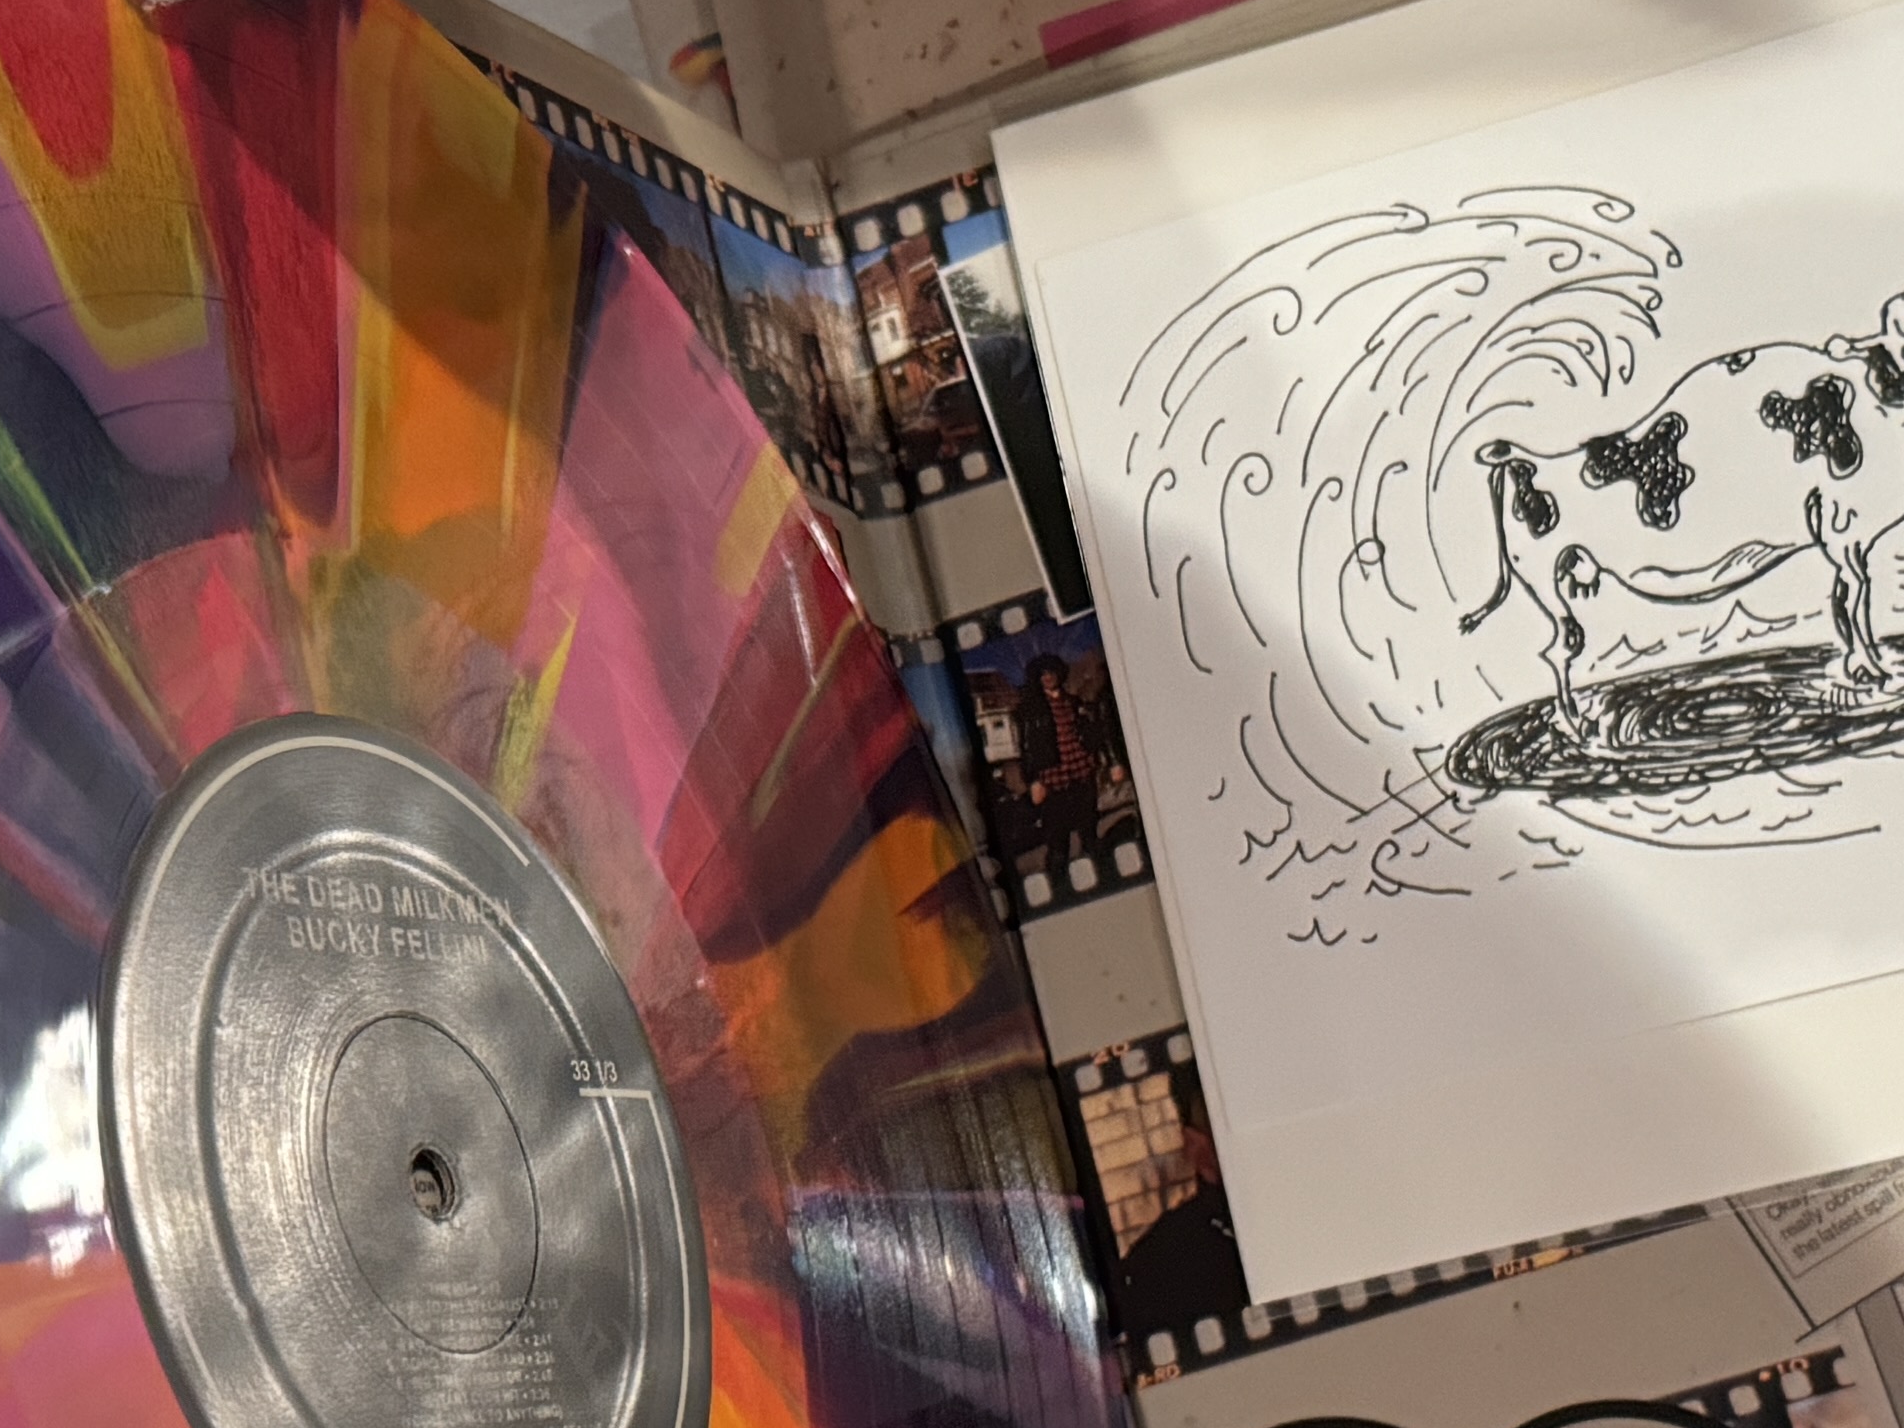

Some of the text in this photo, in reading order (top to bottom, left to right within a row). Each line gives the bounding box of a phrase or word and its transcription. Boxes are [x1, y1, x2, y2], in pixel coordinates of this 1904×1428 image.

[308, 875, 382, 913] DEAD
[289, 916, 380, 956] BUCKY
[570, 1060, 617, 1084] 33 1/3
